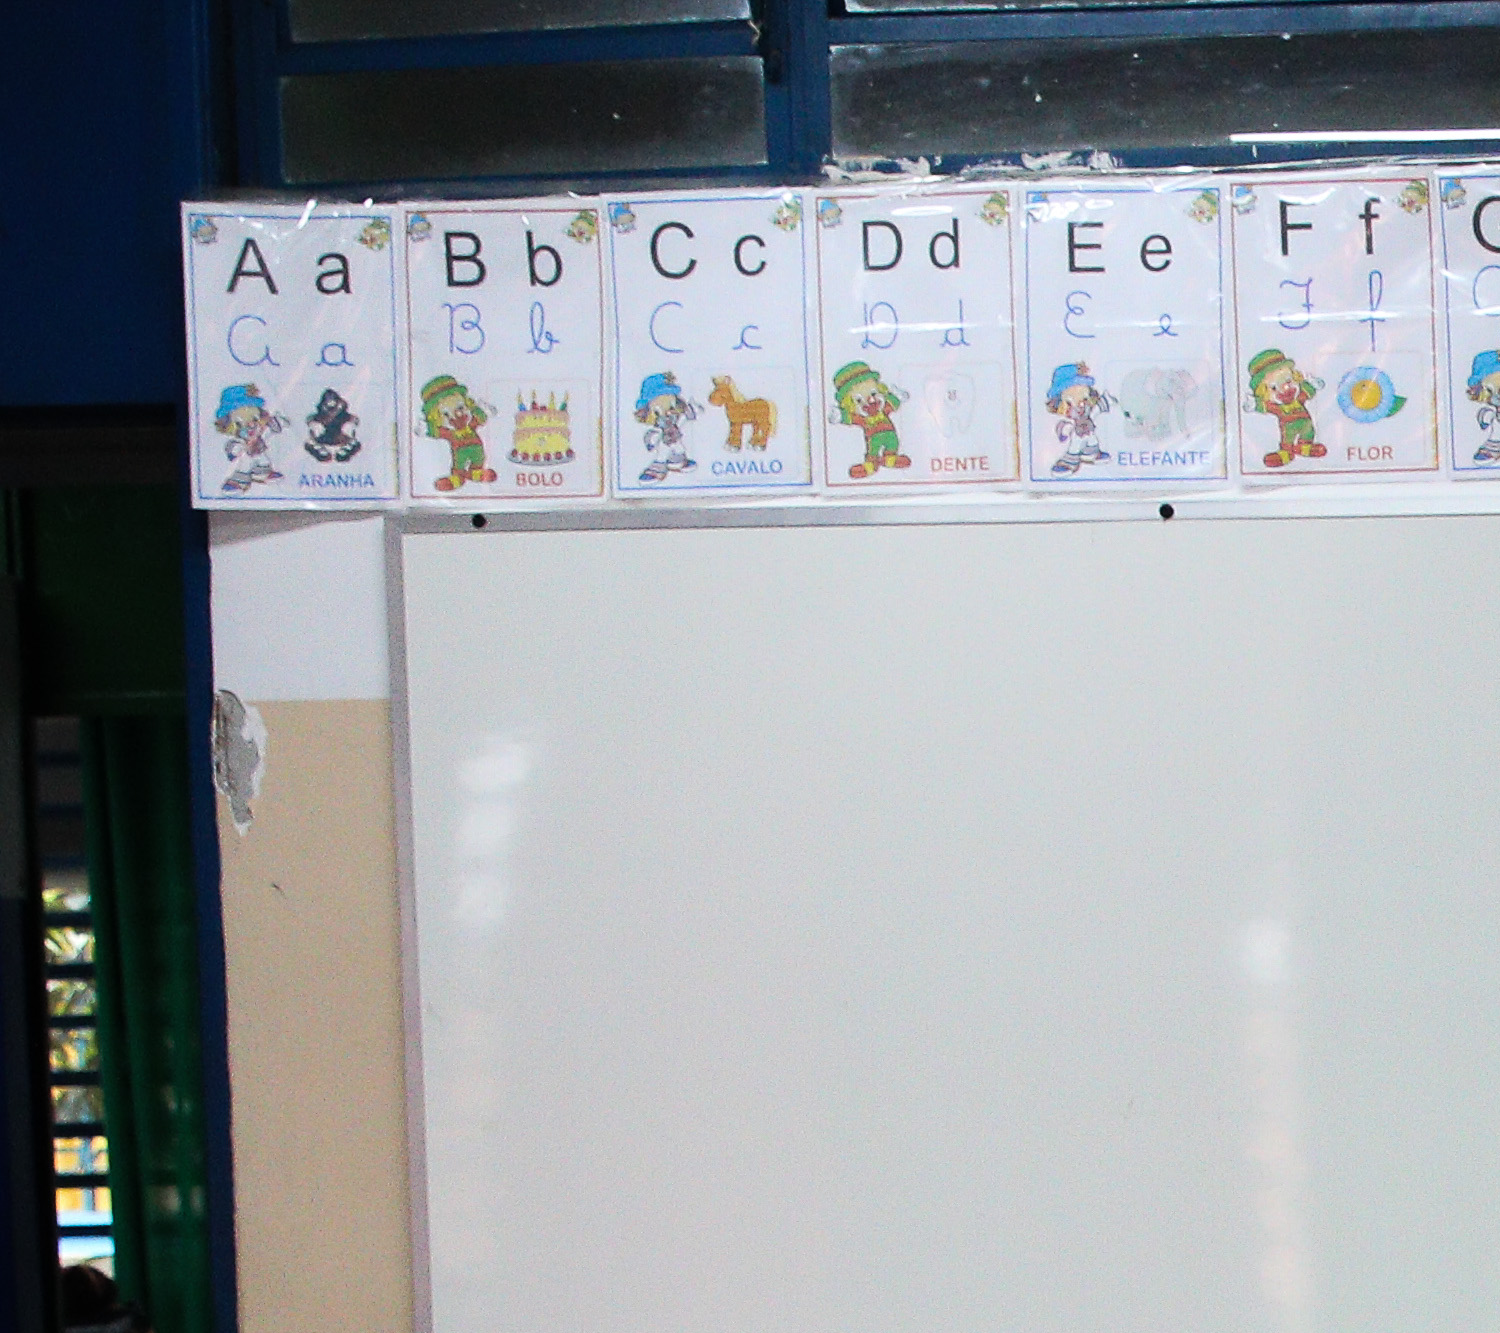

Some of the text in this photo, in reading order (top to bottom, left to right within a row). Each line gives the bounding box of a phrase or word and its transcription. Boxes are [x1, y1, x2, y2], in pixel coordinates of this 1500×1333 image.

[1280, 198, 1381, 256] F f
[443, 231, 563, 287] B b
[651, 221, 767, 279] C c
[862, 219, 960, 271] D d
[1068, 222, 1173, 274] E e
[226, 239, 353, 295] A a
[711, 460, 782, 475] CAVALO
[931, 456, 990, 472] DENTE
[1117, 450, 1210, 468] ELEFANTE
[1346, 446, 1393, 461] FLOR
[299, 473, 375, 488] ARANHA
[516, 472, 563, 487] BOLO
